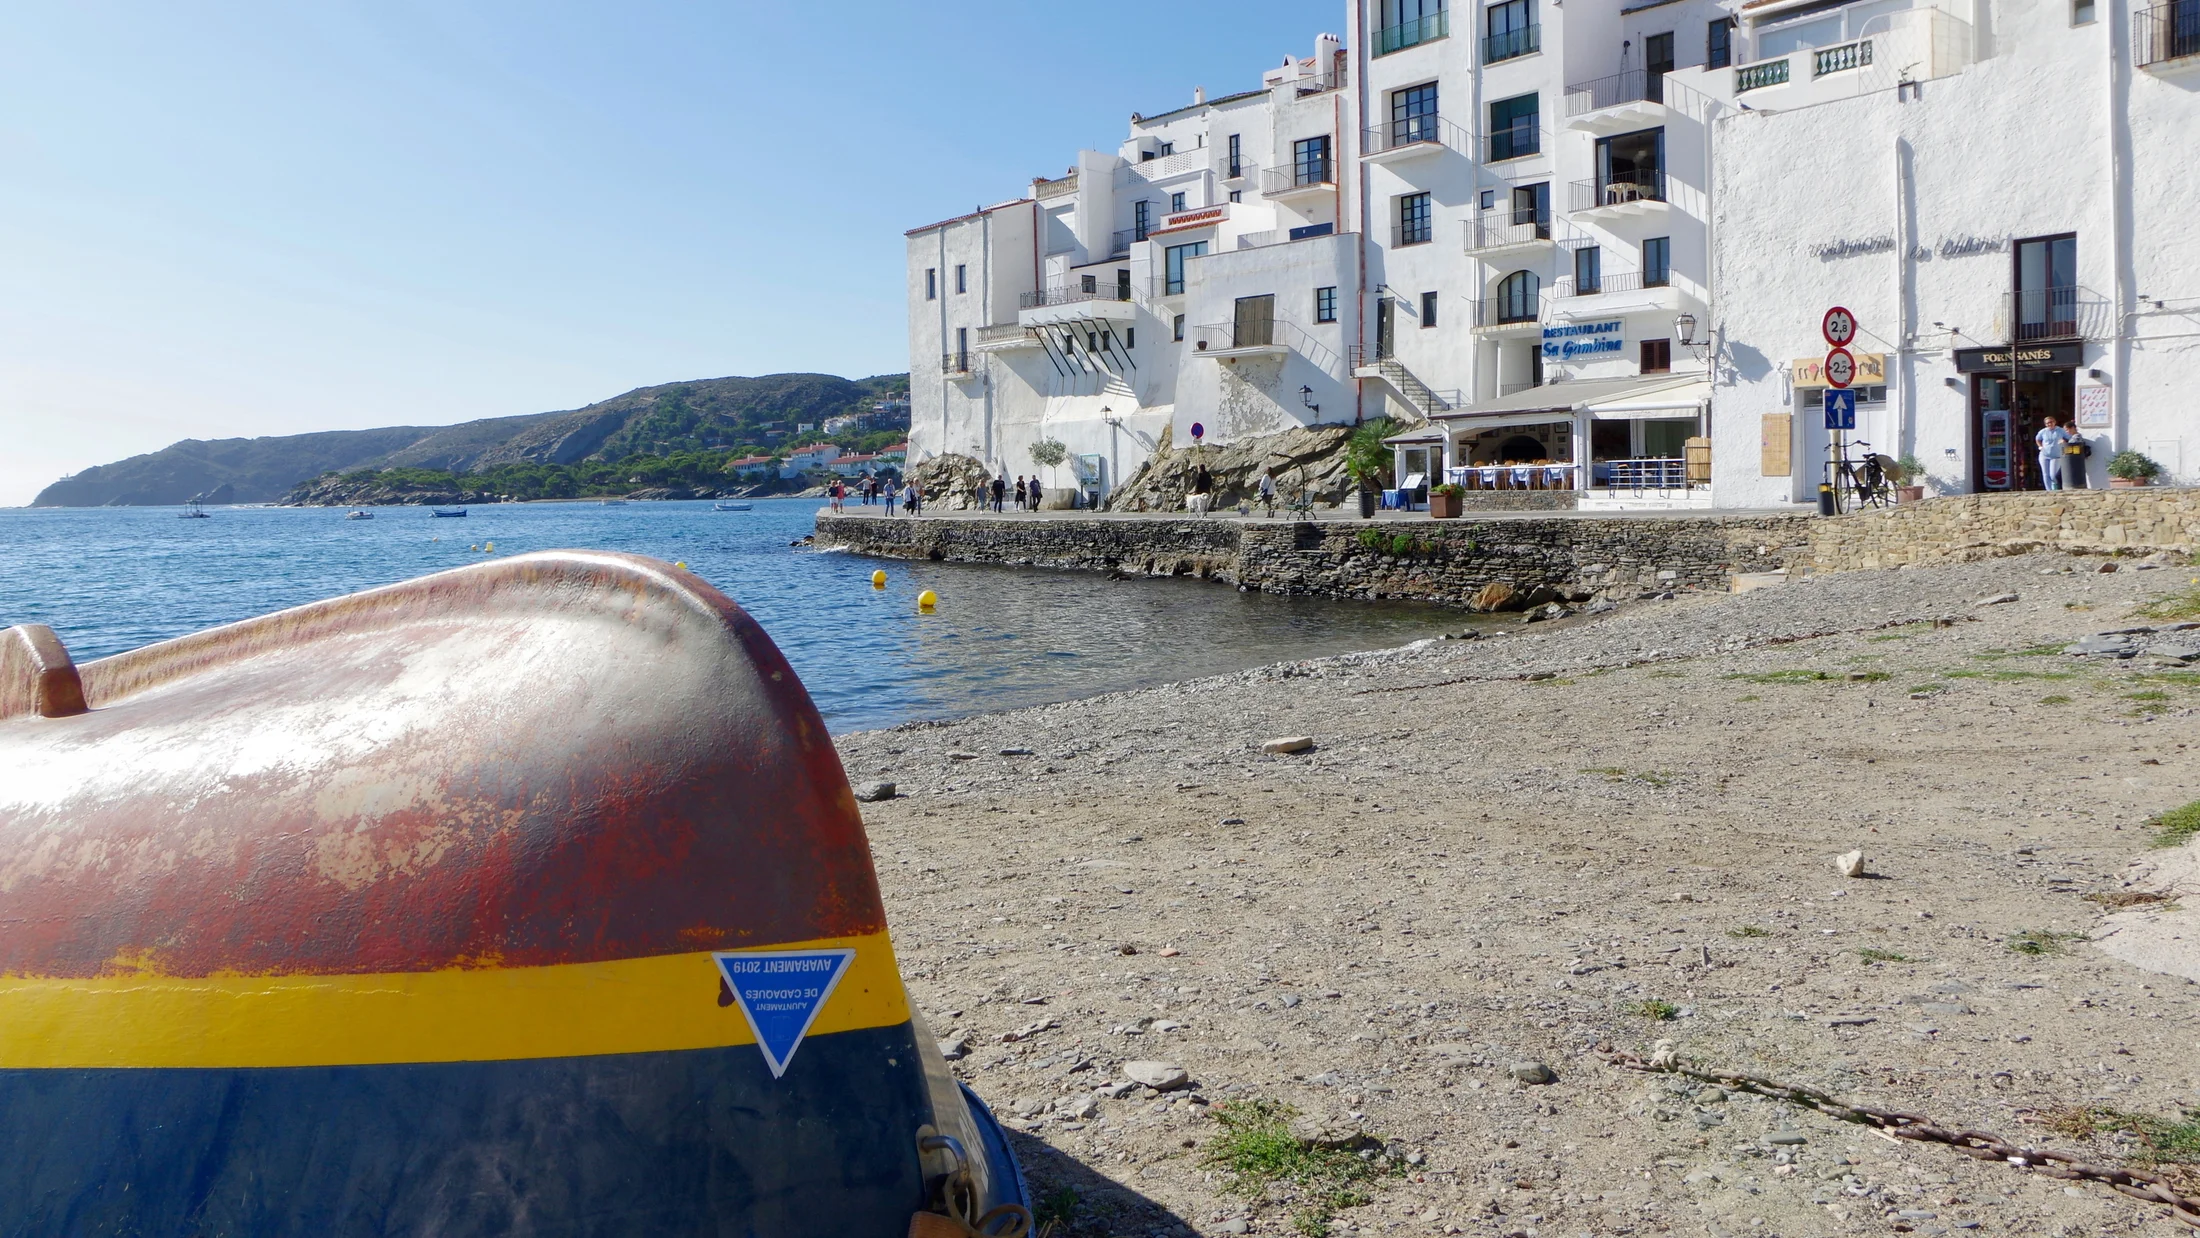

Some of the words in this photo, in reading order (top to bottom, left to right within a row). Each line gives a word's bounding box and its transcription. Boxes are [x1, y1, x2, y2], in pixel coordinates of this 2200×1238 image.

[1543, 321, 1622, 338] RESTAURANT
[1831, 321, 1848, 333] 2,8
[1543, 342, 1560, 357] Sa
[1562, 337, 1622, 360] Gambina
[1983, 353, 2014, 363] FORN
[1833, 362, 1847, 375] 2,2
[733, 961, 760, 973] 2019
[763, 959, 832, 973] AVARAMENT
[745, 989, 802, 1002] CADAQUÉS
[804, 988, 818, 998] DE
[756, 1002, 808, 1011] AJUNTAMENT
